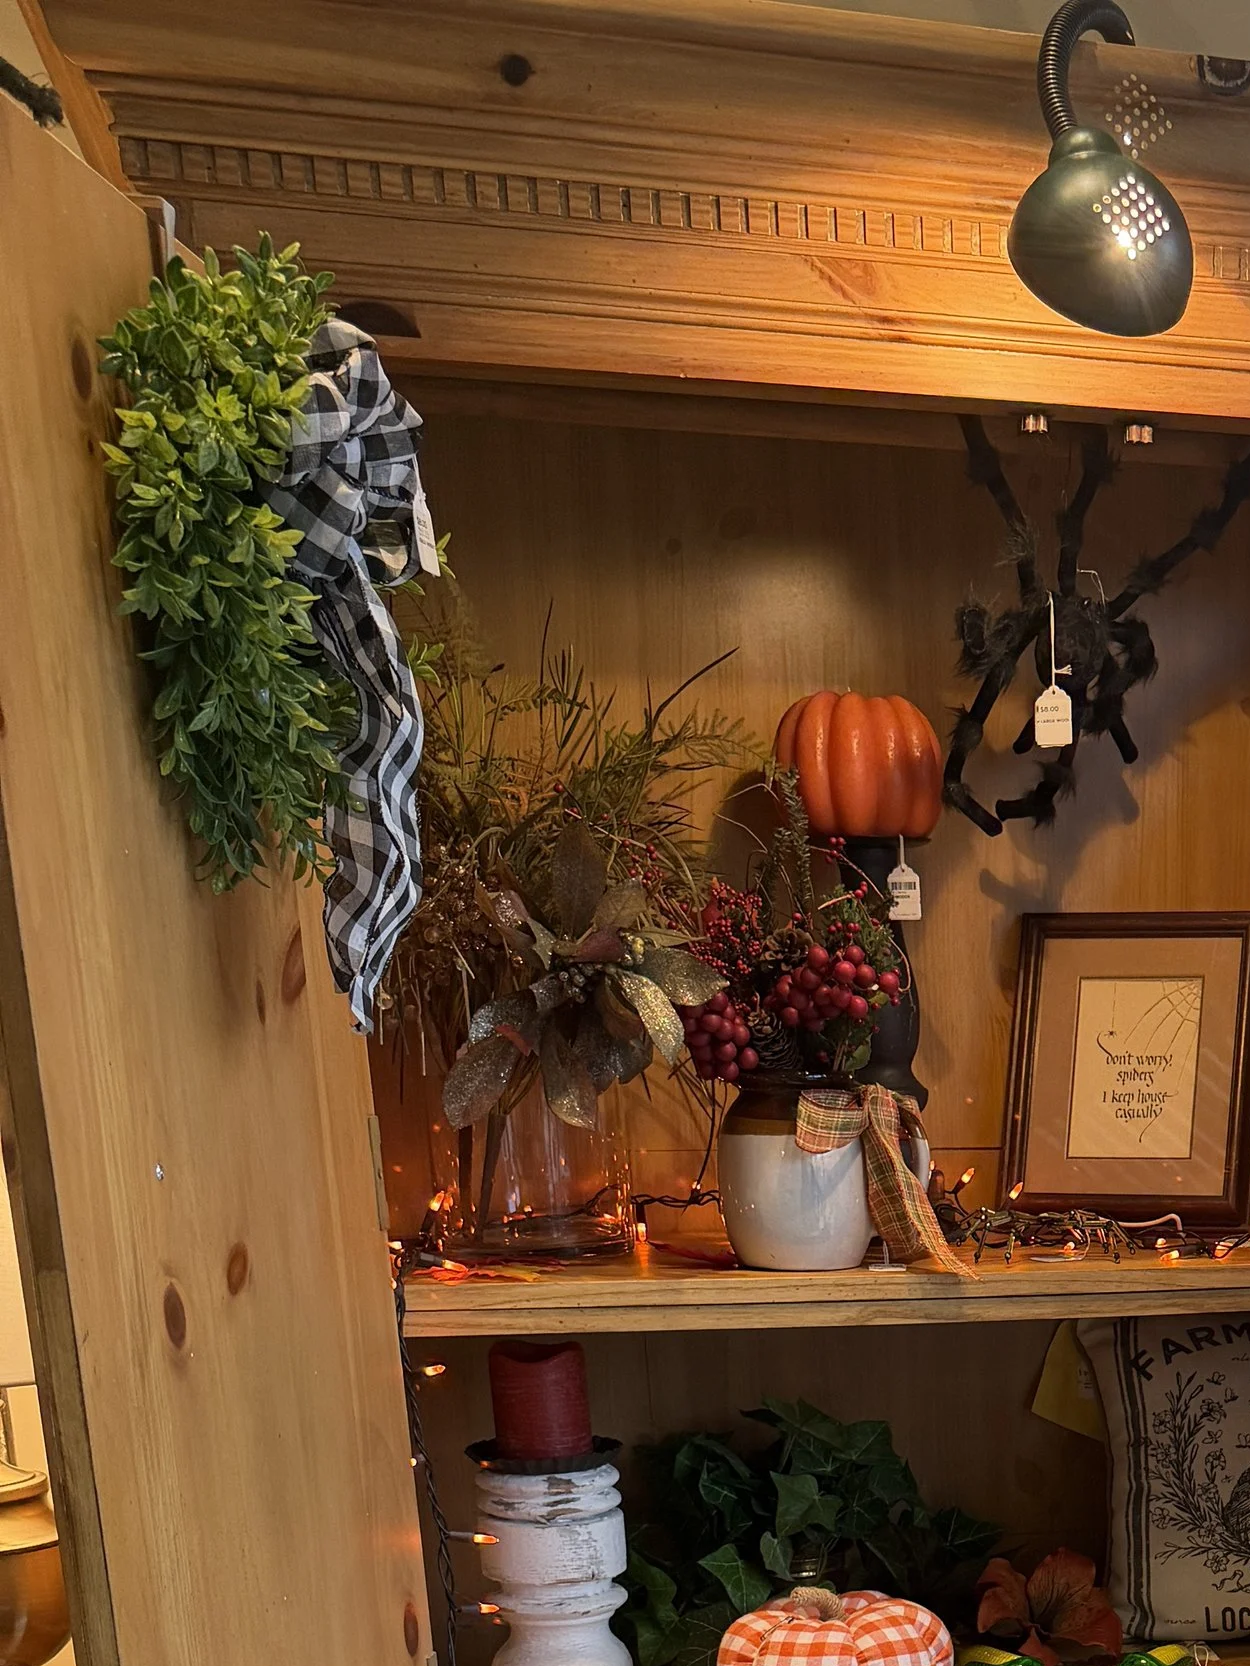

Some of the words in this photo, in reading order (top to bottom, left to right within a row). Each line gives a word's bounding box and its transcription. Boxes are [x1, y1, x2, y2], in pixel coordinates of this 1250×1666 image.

[1103, 1091, 1107, 1103] I
[1111, 1089, 1135, 1106] keep
[1137, 1088, 1179, 1104] house
